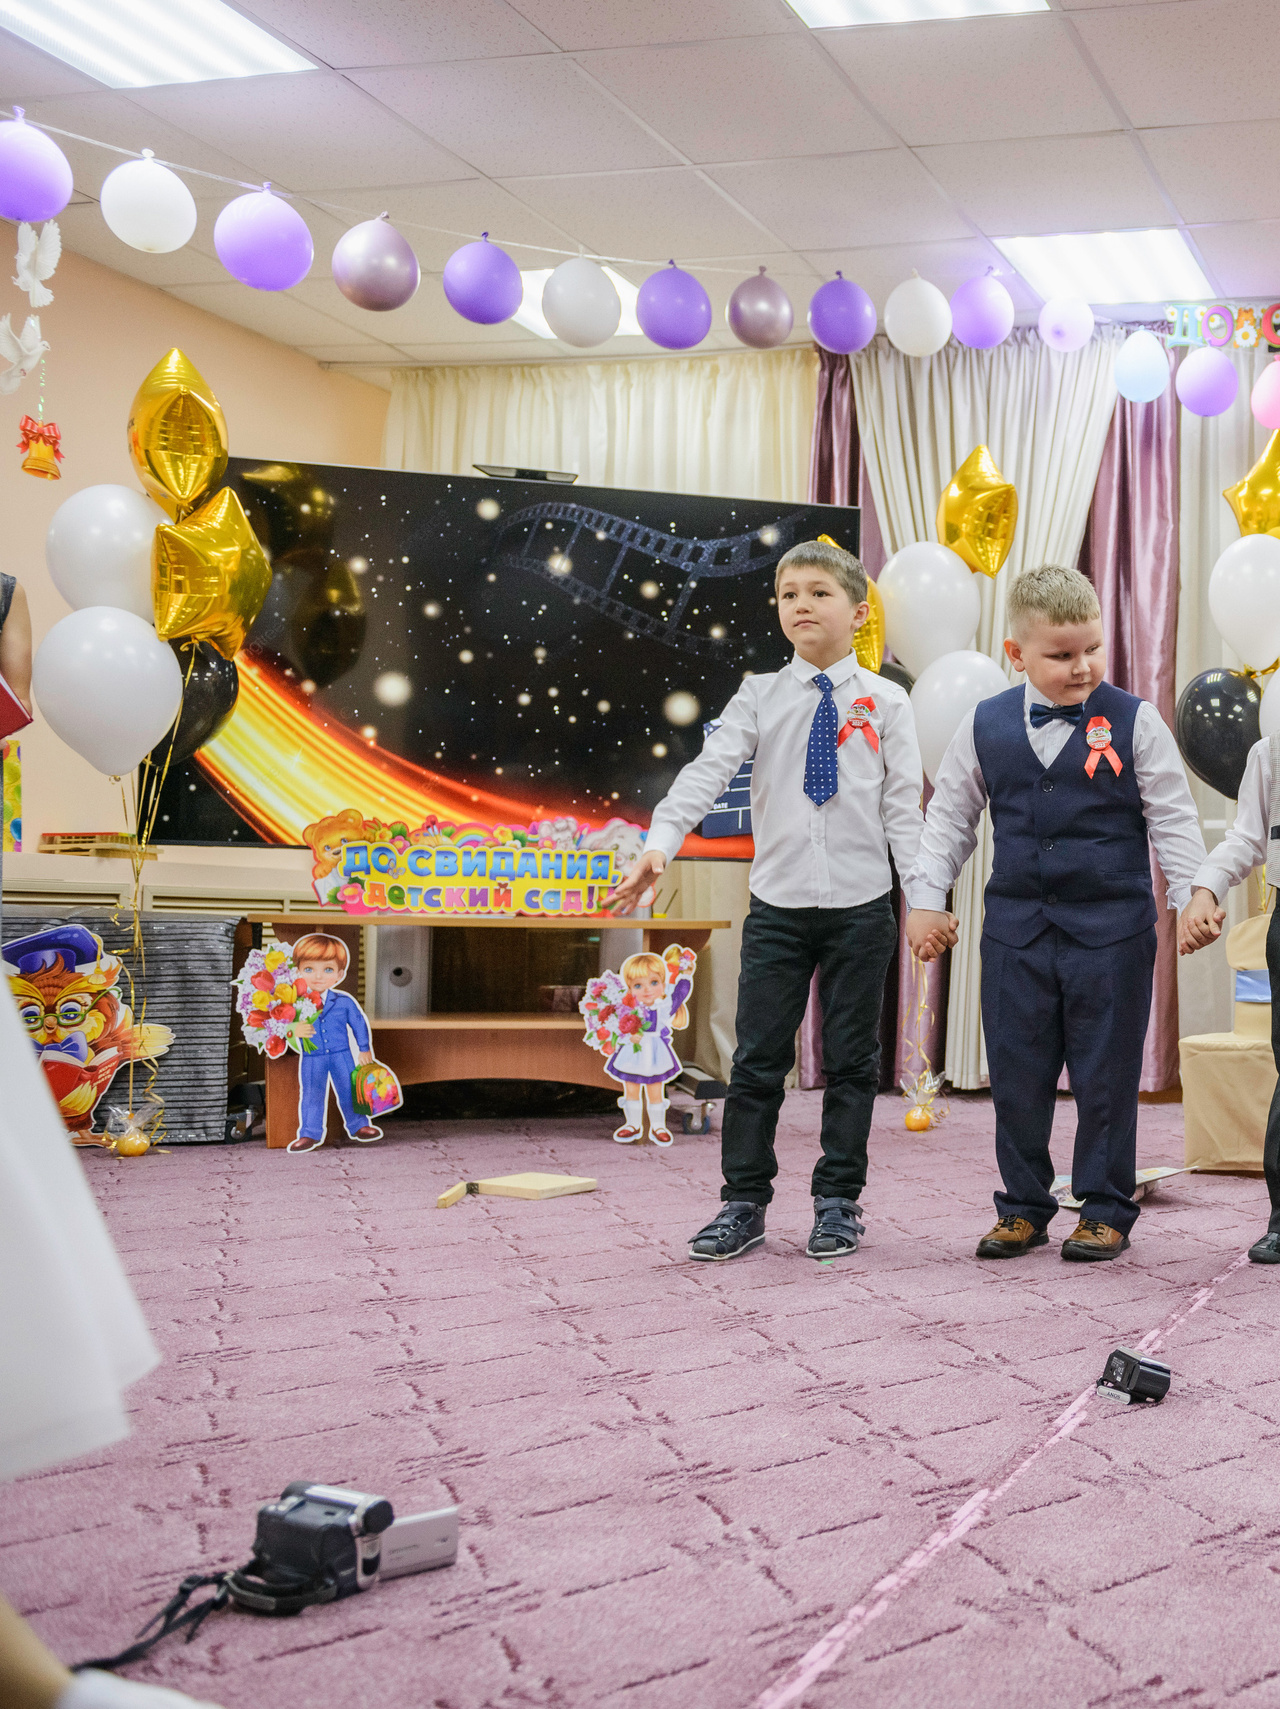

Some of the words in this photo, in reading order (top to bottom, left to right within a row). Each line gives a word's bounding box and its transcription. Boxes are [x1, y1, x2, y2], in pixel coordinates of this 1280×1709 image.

[1166, 302, 1234, 348] ДО
[342, 845, 398, 878] ДО
[407, 849, 620, 884] СВИДАНИЯ,
